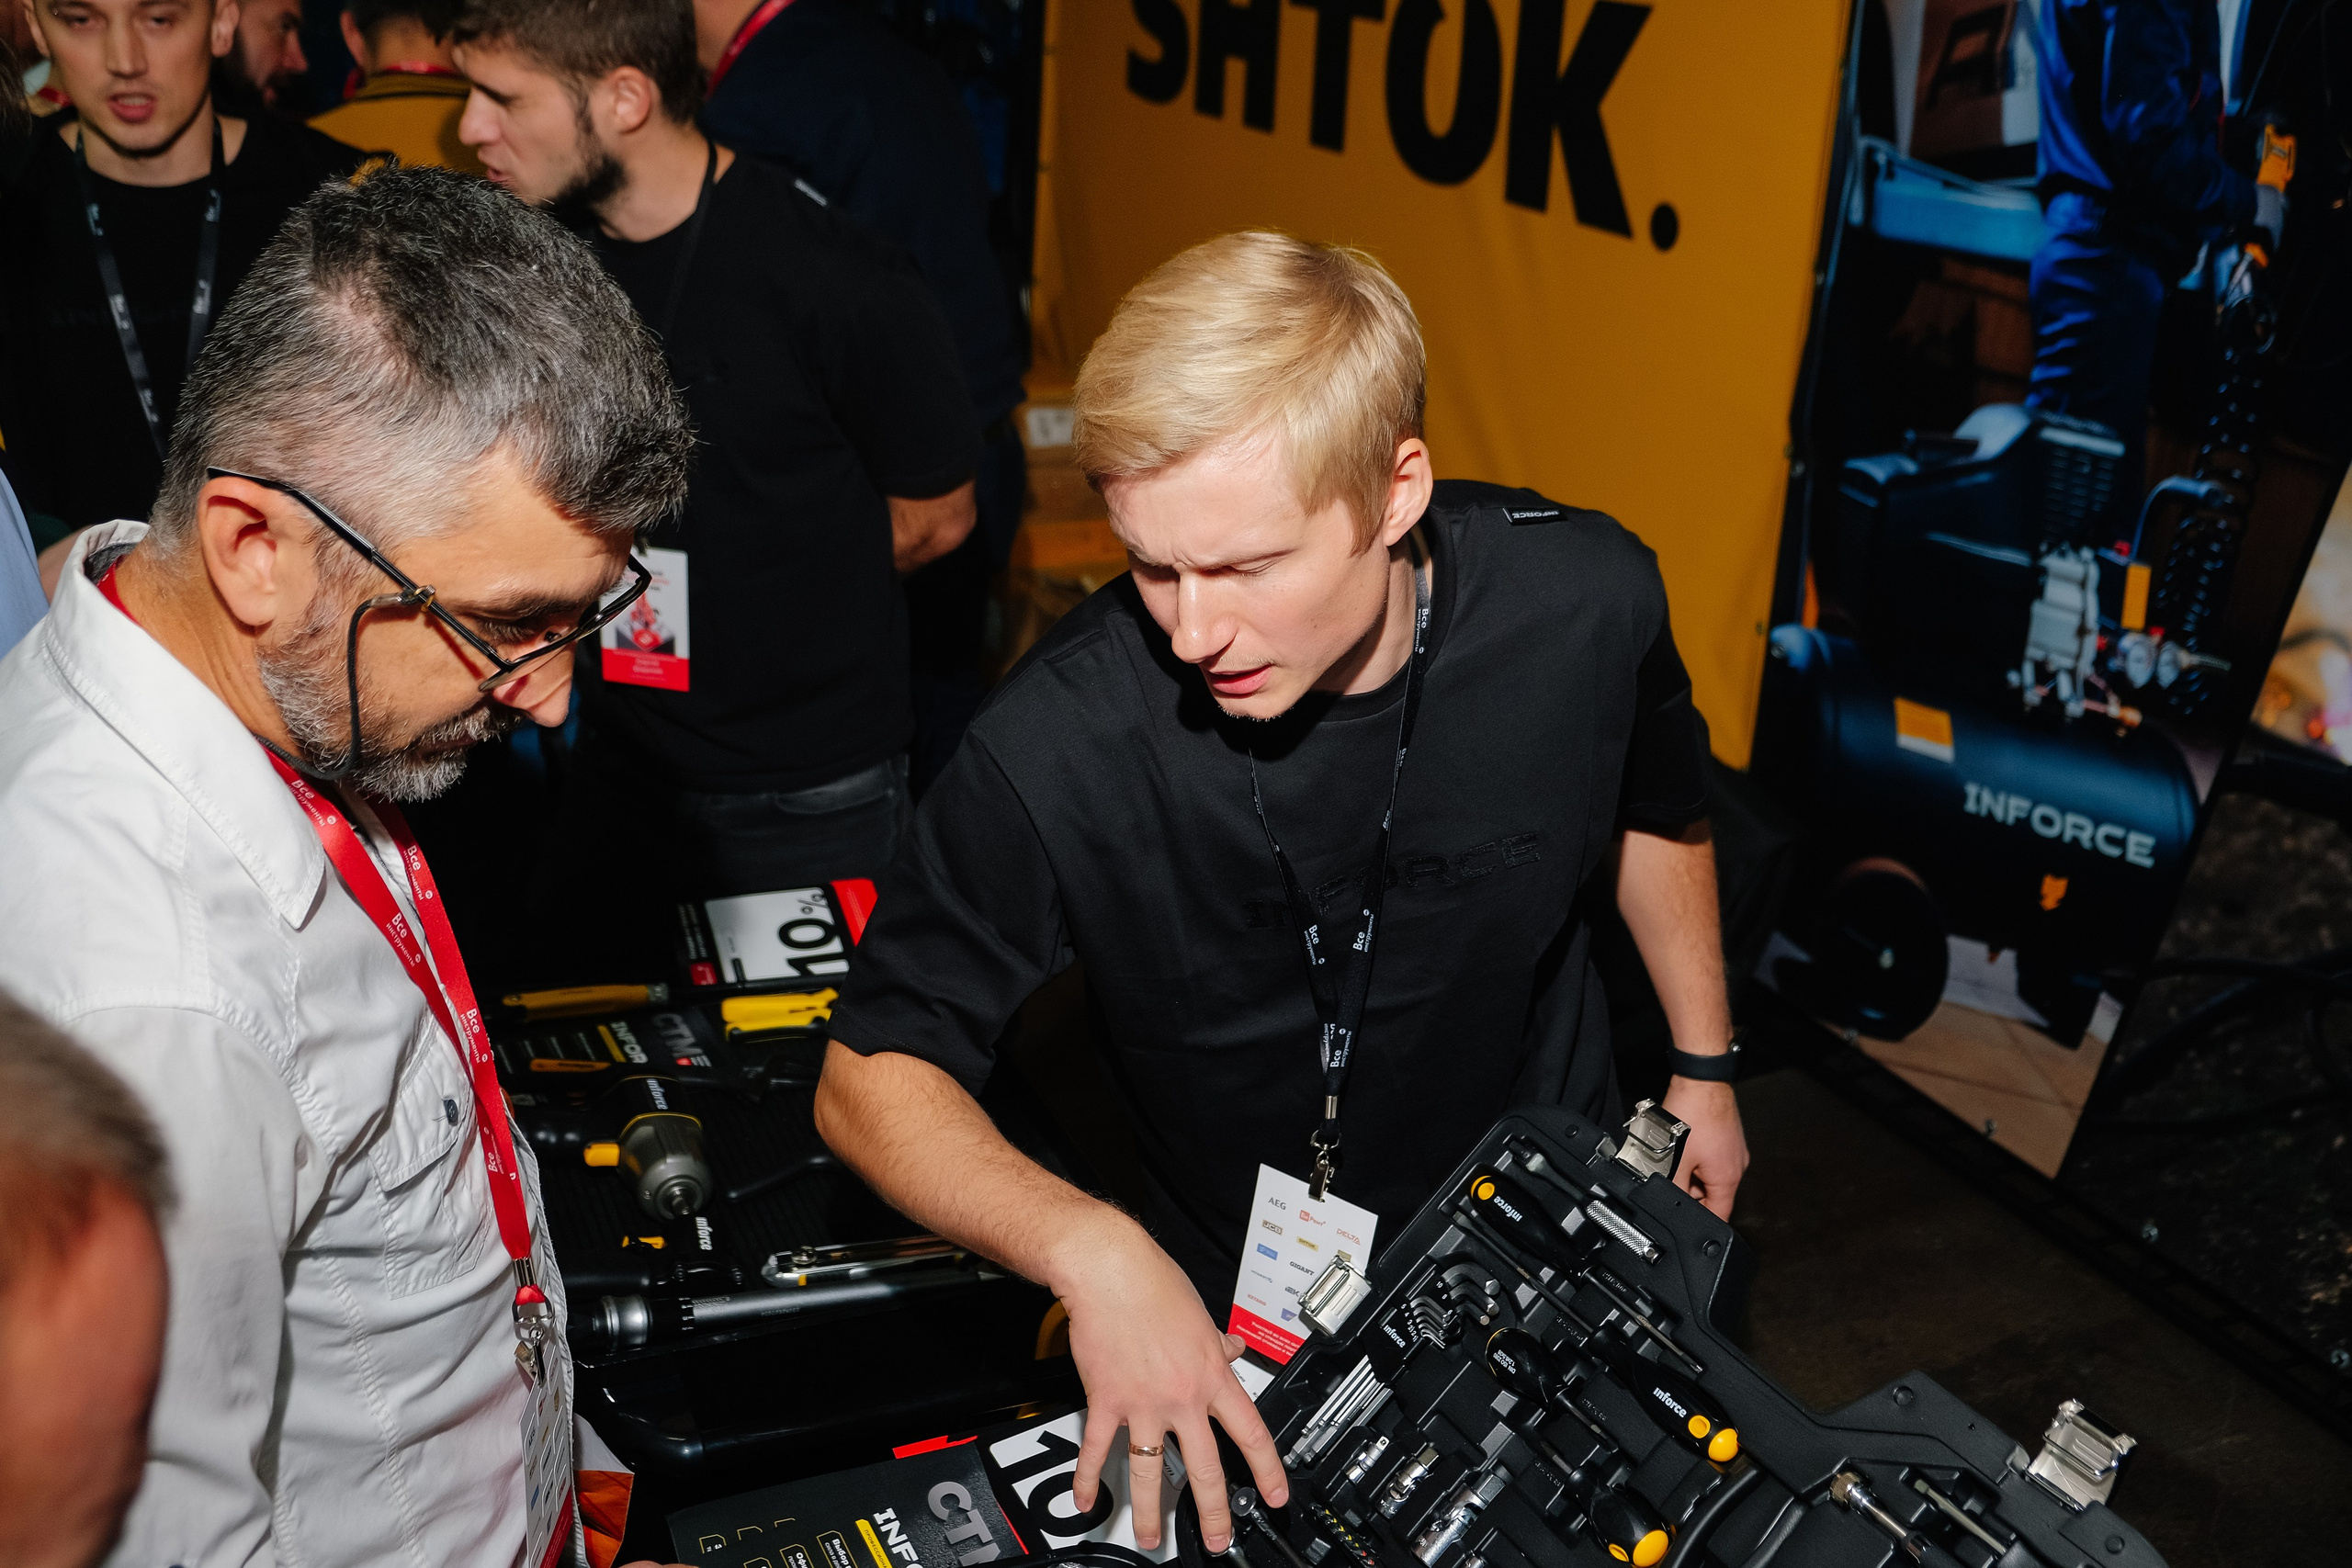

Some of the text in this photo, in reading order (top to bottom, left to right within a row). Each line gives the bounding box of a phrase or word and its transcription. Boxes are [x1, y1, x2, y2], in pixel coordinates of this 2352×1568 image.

[1126, 0, 1679, 253] SHTOK.
[290, 779, 315, 800] Все
[1963, 782, 2156, 869] INFORCE
[407, 844, 422, 871] Все
[391, 911, 408, 939] Все
[1308, 924, 1319, 945] Все
[1363, 914, 1374, 953] инструменты
[386, 922, 415, 967] инструменты
[1304, 930, 1317, 965] инструменты
[1352, 931, 1365, 951] Все
[466, 1008, 481, 1033] Все
[460, 1013, 481, 1064] инструменты
[1340, 1031, 1352, 1067] инструменты
[1329, 1049, 1342, 1068] Все
[1268, 1196, 1286, 1211] AEG
[1493, 1195, 1523, 1223] inforce
[695, 1216, 714, 1251] inforce
[1263, 1222, 1282, 1234] JCB
[1336, 1228, 1361, 1246] DELTA
[1289, 1260, 1315, 1276] GIGANT
[1383, 1325, 1406, 1348] inforce
[1653, 1386, 1688, 1418] inforce
[1000, 1429, 1114, 1538] 10
[831, 1538, 850, 1565] Выбор
[873, 1507, 923, 1568] INF
